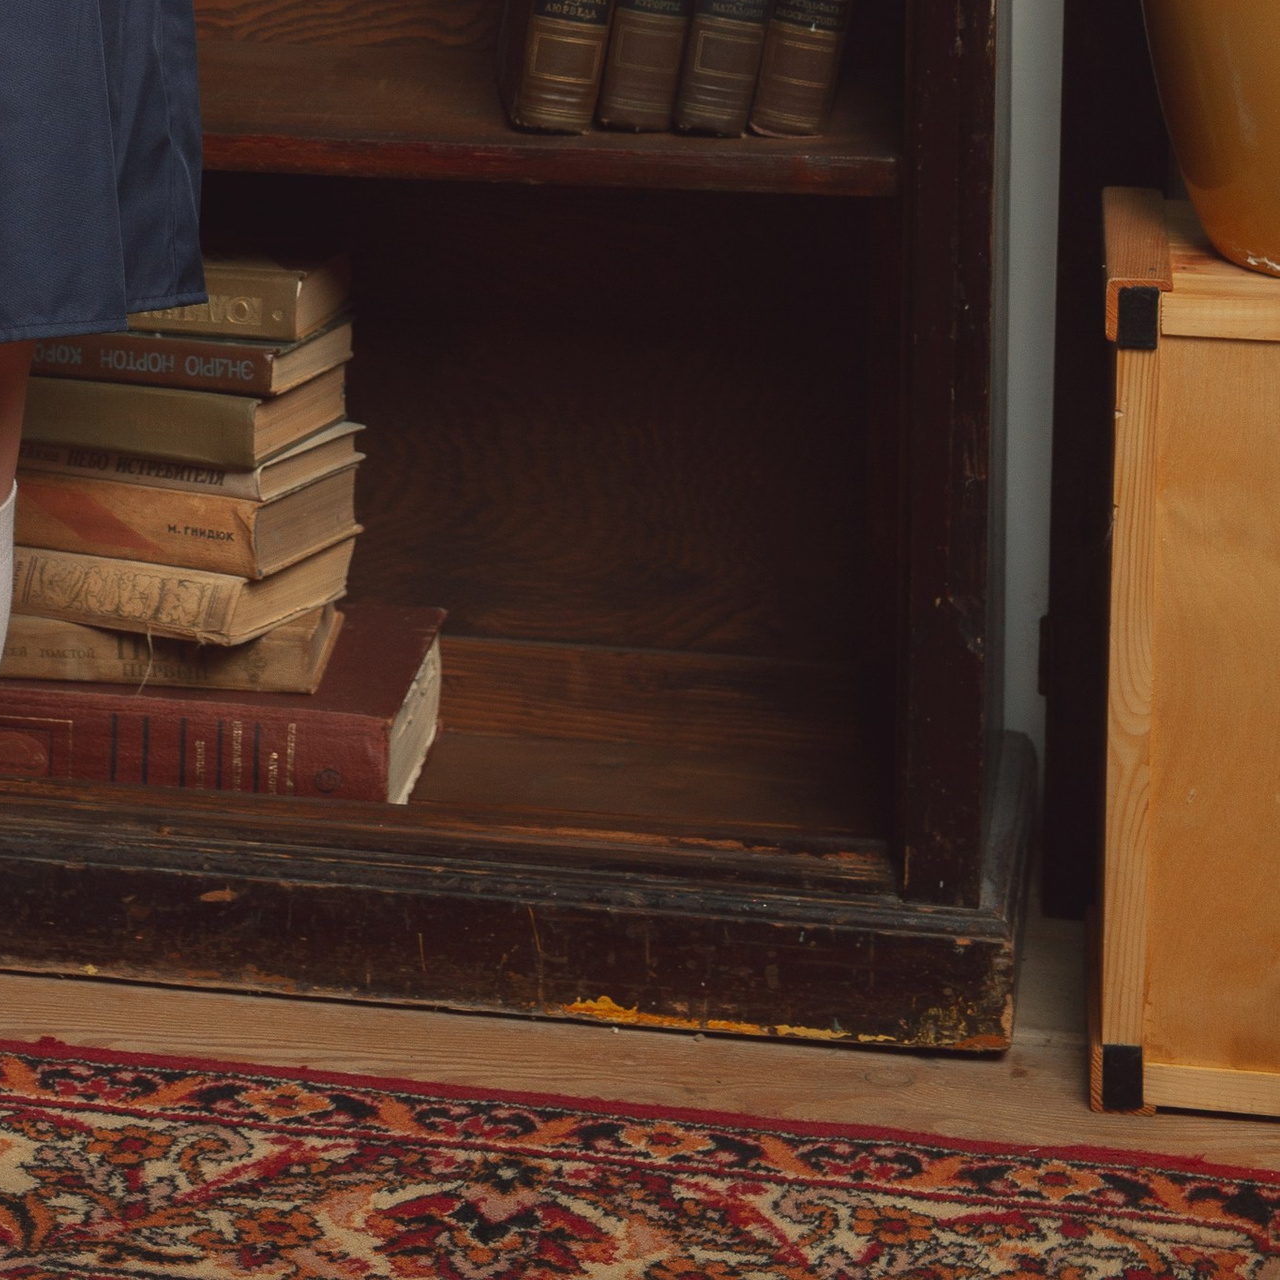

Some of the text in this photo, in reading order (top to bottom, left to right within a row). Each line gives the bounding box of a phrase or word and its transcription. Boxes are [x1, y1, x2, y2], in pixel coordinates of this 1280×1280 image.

[100, 349, 174, 374] НОРТОН
[185, 355, 255, 380] ЭНДРЮ
[66, 450, 226, 487] НЕБО ИСТРЕБИТЕЛЯ
[183, 524, 235, 542] ГНИДЮК
[38, 646, 96, 660] ТОЛСТОЙ
